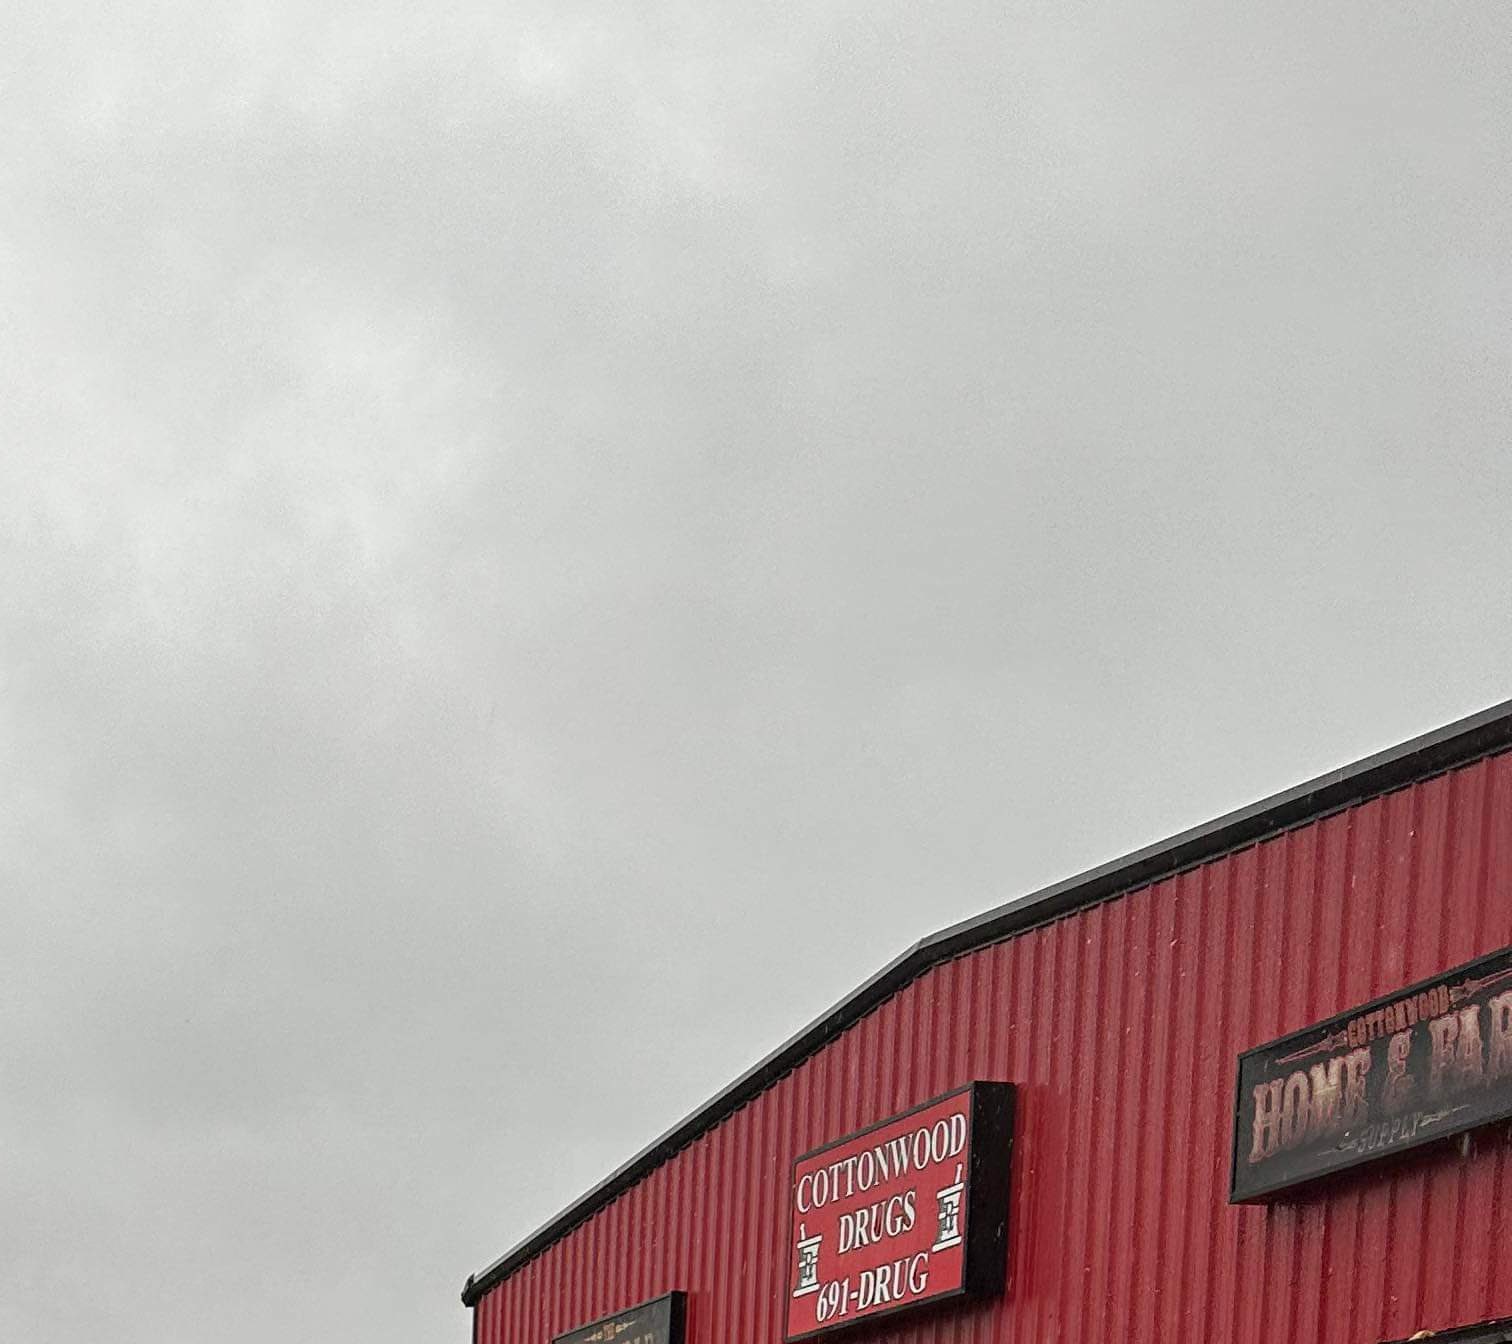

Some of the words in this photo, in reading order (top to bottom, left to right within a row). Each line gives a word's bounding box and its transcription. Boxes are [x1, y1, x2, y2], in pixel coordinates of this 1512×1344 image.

[1248, 1046, 1372, 1164] HOME
[796, 1112, 967, 1214] COTTONWOOD
[838, 1190, 917, 1255] DRUGS
[815, 1252, 930, 1323] 691-DRUG
